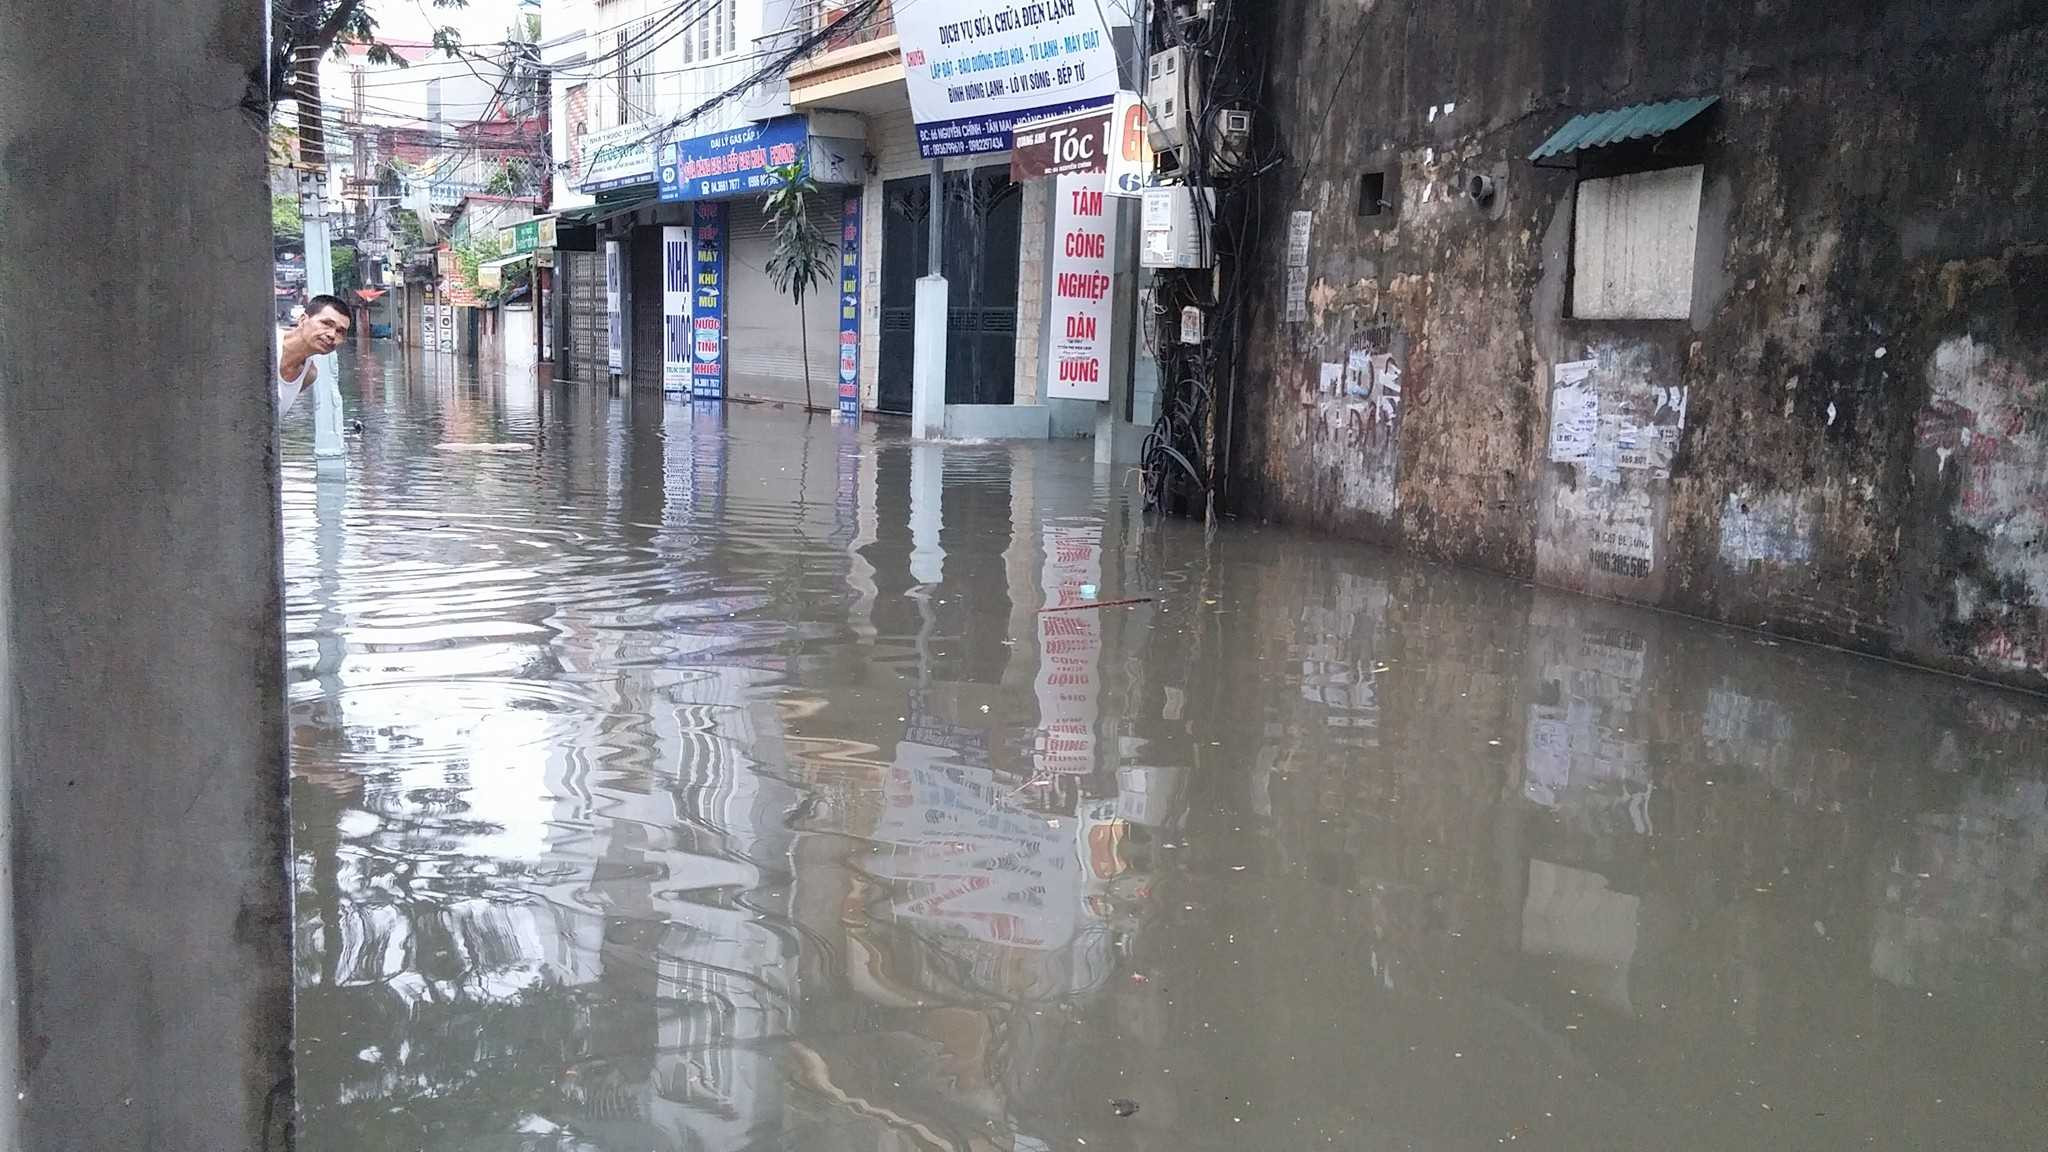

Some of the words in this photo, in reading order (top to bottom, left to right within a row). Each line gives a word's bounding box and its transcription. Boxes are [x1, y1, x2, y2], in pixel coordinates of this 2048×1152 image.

[939, 25, 960, 48] DỊCH
[962, 24, 974, 44] VỤ
[975, 10, 994, 38] SỬA
[994, 5, 1021, 32] CHỮA
[1022, 1, 1046, 29] ĐIỆN
[1048, 0, 1075, 24] LẠNH
[1040, 40, 1058, 64] LẠNH
[1064, 32, 1082, 53] MÁY
[986, 83, 1004, 100] LẠNH
[1009, 74, 1020, 94] LÒ
[1021, 75, 1029, 90] VI
[1030, 70, 1051, 89] SÓNG
[1057, 62, 1073, 85] BẾP
[1074, 59, 1086, 81] TỪ
[729, 133, 743, 146] GAS
[743, 128, 755, 143] CẤP
[961, 121, 982, 137] CHÍNH
[998, 120, 1013, 134] MAI
[1050, 127, 1093, 164] Tóc
[1072, 186, 1103, 216] TÂM
[1065, 228, 1105, 258] CÔNG
[667, 229, 690, 292] NHÀ
[698, 269, 719, 285] KHỬ
[1057, 270, 1110, 304] NGHIỆP
[666, 296, 691, 363] THUỐC
[1066, 312, 1096, 341] DÂN
[1059, 358, 1099, 387] DỤNG
